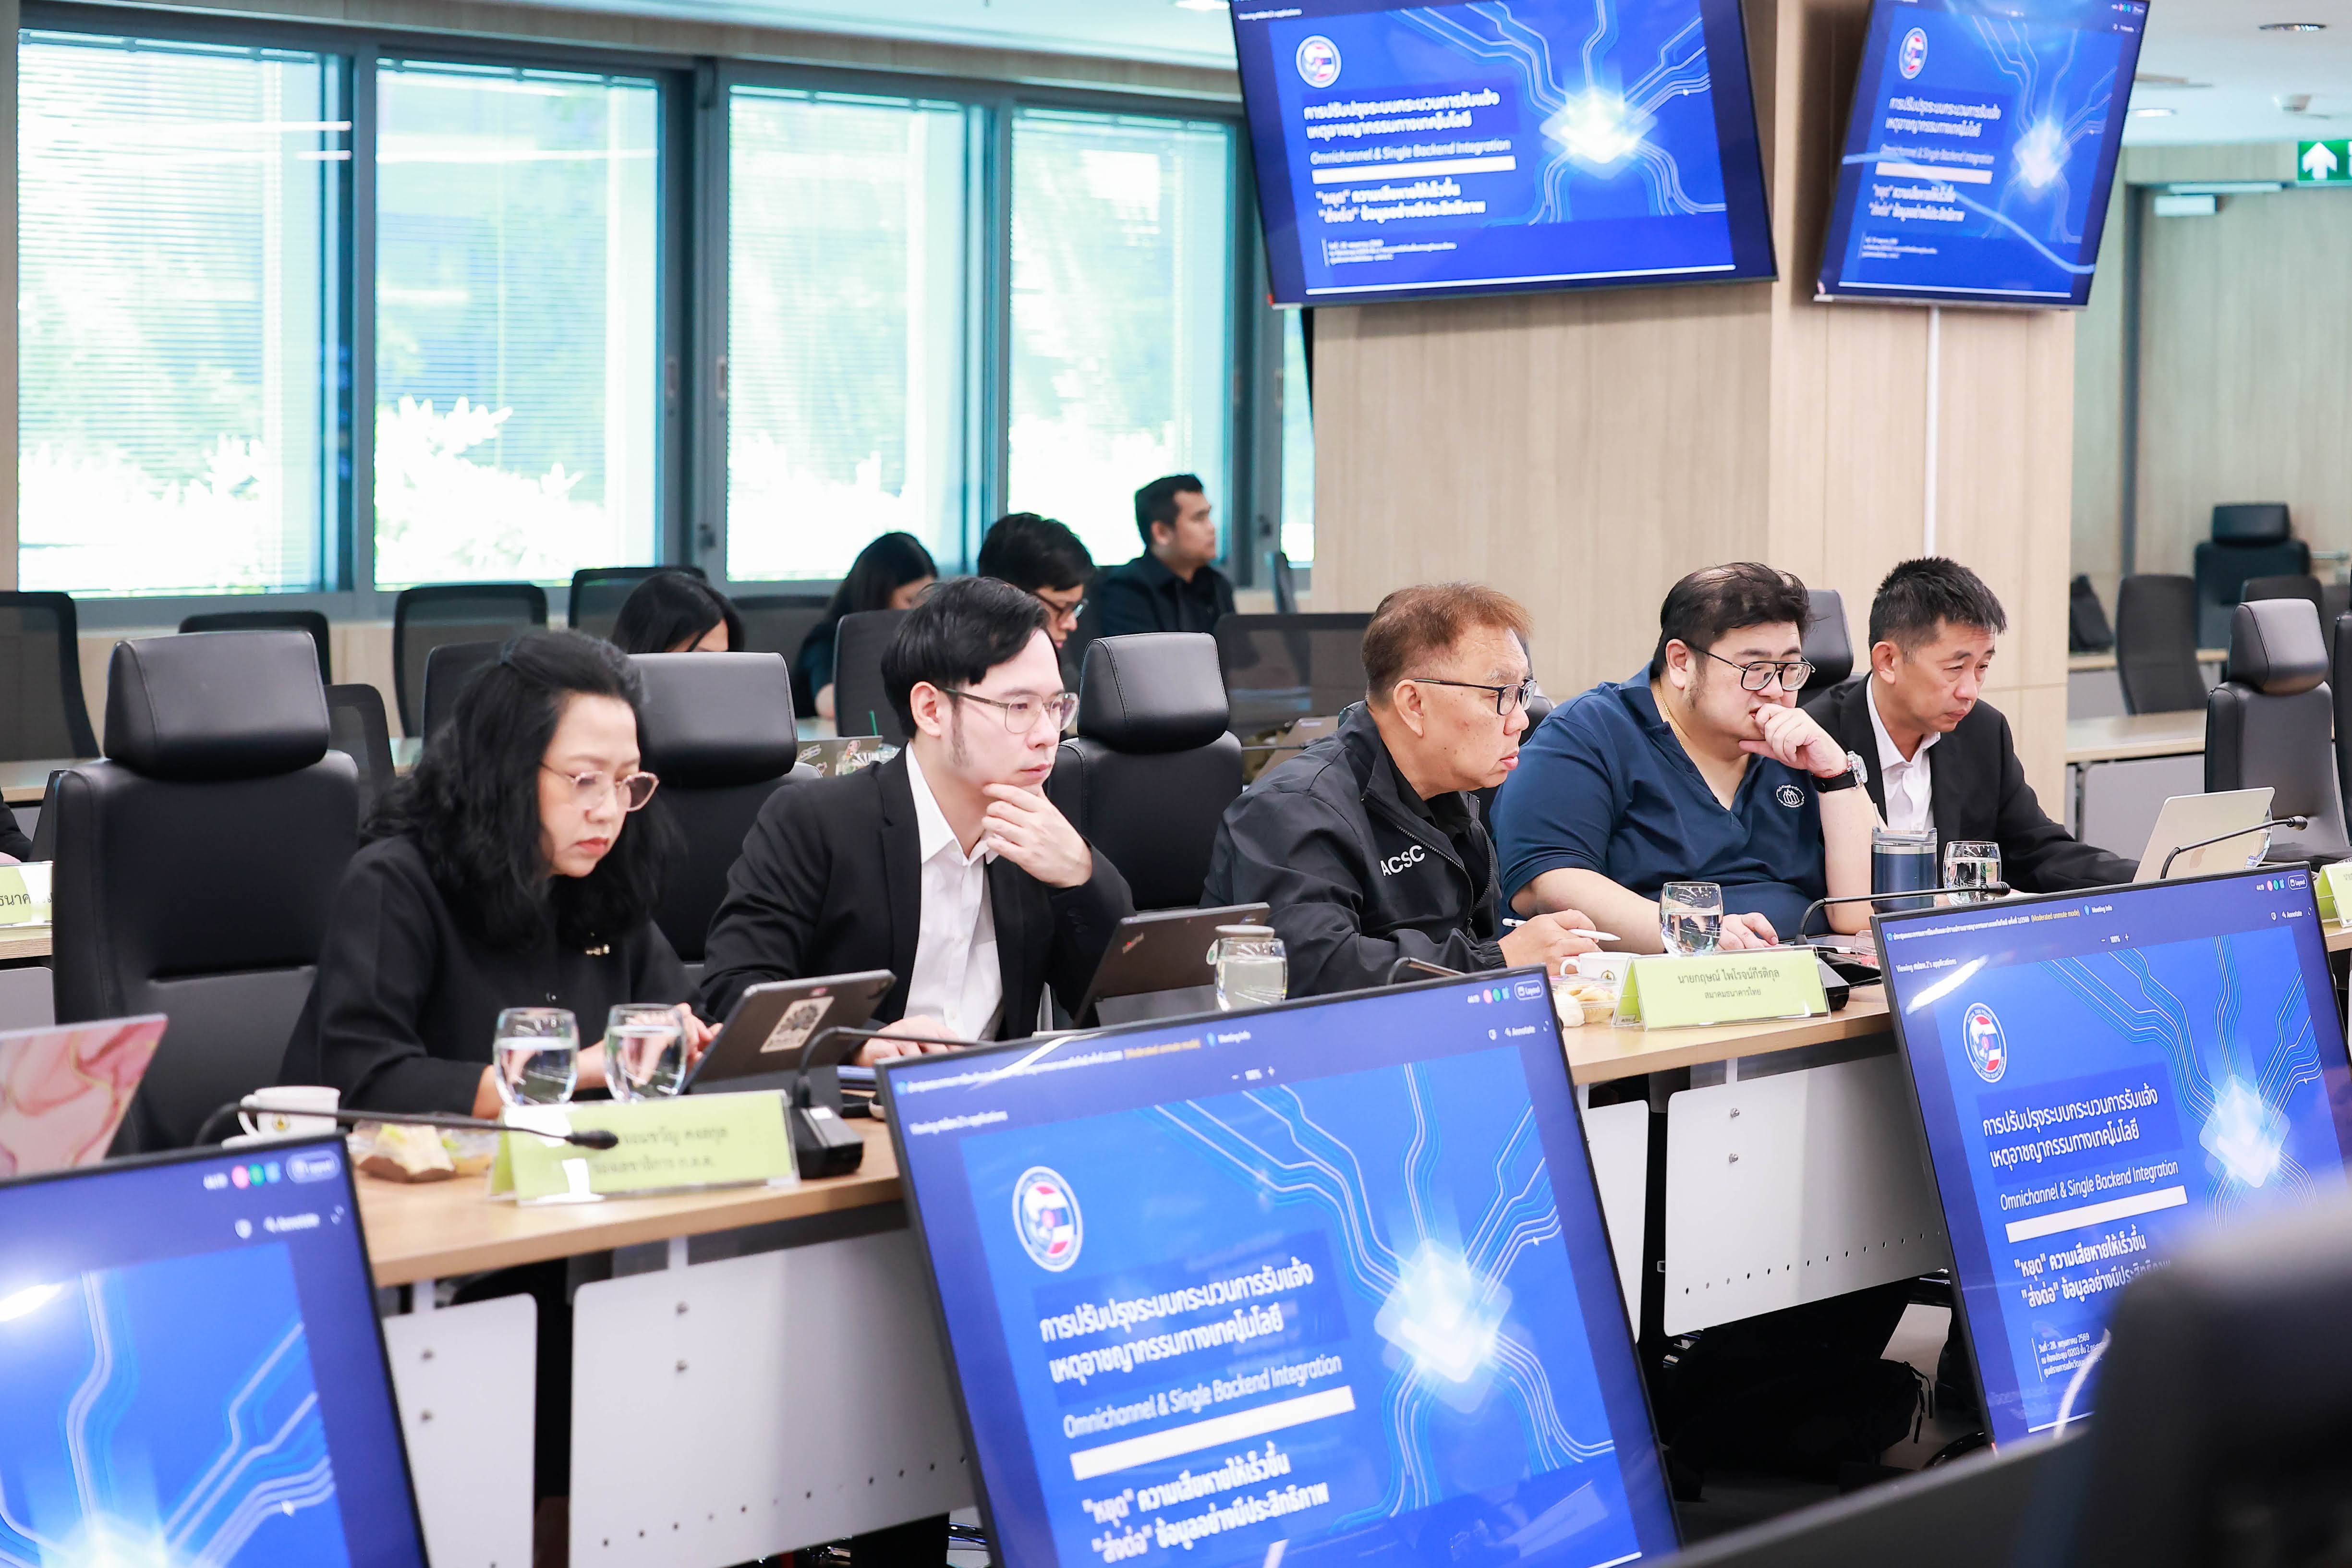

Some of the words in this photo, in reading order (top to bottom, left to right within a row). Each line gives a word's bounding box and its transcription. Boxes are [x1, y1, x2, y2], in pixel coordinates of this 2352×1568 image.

[1381, 845, 1425, 876] ACSC
[2294, 878, 2306, 887] Layout
[2031, 912, 2053, 923] (Moderated
[1896, 964, 1914, 972] Viewing
[1932, 958, 1958, 969] applications
[1704, 986, 1761, 999] สมาคมธนาคารไทย
[1983, 1083, 2158, 1136] การปรับปรุงระบบกระบวนการรับแจ้ง
[1989, 1118, 2139, 1171] เหตุอาชญากรรมทางเทคโนโลยี
[2000, 1183, 2059, 1210] Omnichannel
[2060, 1182, 2067, 1198] &
[2068, 1176, 2094, 1197] Single
[2096, 1167, 2132, 1190] Backend
[2133, 1160, 2178, 1182] Integration
[2077, 1333, 2089, 1343] 2569
[2067, 1347, 2080, 1357] 0203
[1064, 1395, 1157, 1438] Omnichannel
[1158, 1393, 1168, 1415] &
[1169, 1383, 1212, 1413] Single
[1212, 1367, 1270, 1402] Backend
[1271, 1354, 1342, 1387] Integration
